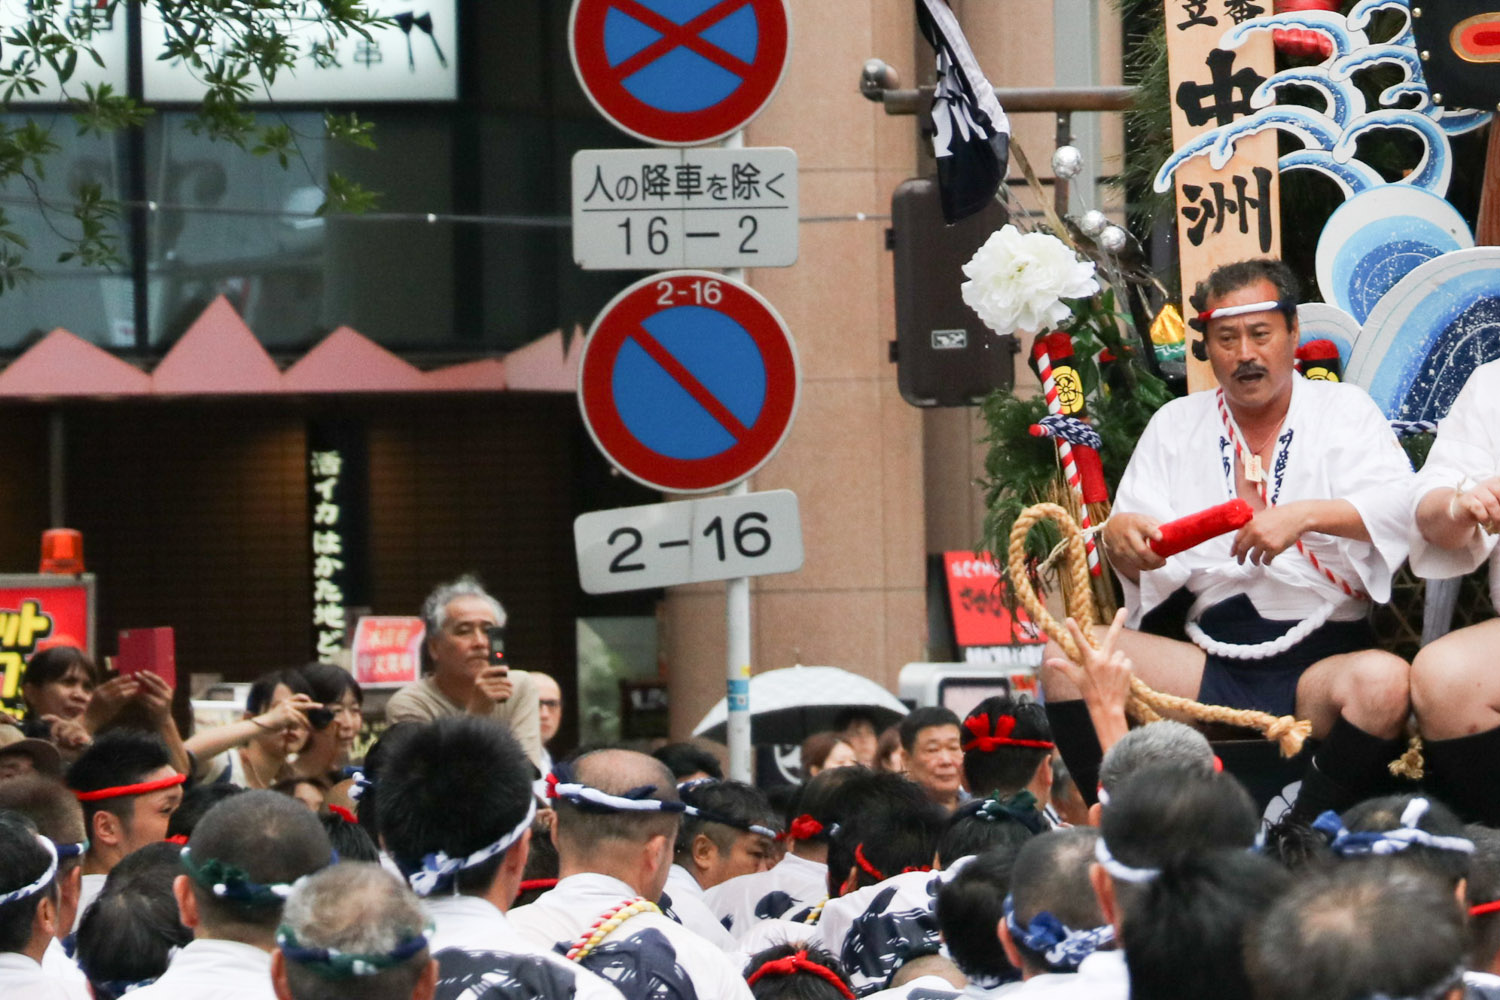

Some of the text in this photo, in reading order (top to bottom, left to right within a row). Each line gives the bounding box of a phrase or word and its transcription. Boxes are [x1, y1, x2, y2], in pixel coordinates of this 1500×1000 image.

[584, 163, 785, 202] 人の降車を除く
[656, 280, 723, 306] 2-16
[606, 512, 772, 574] 2-16
